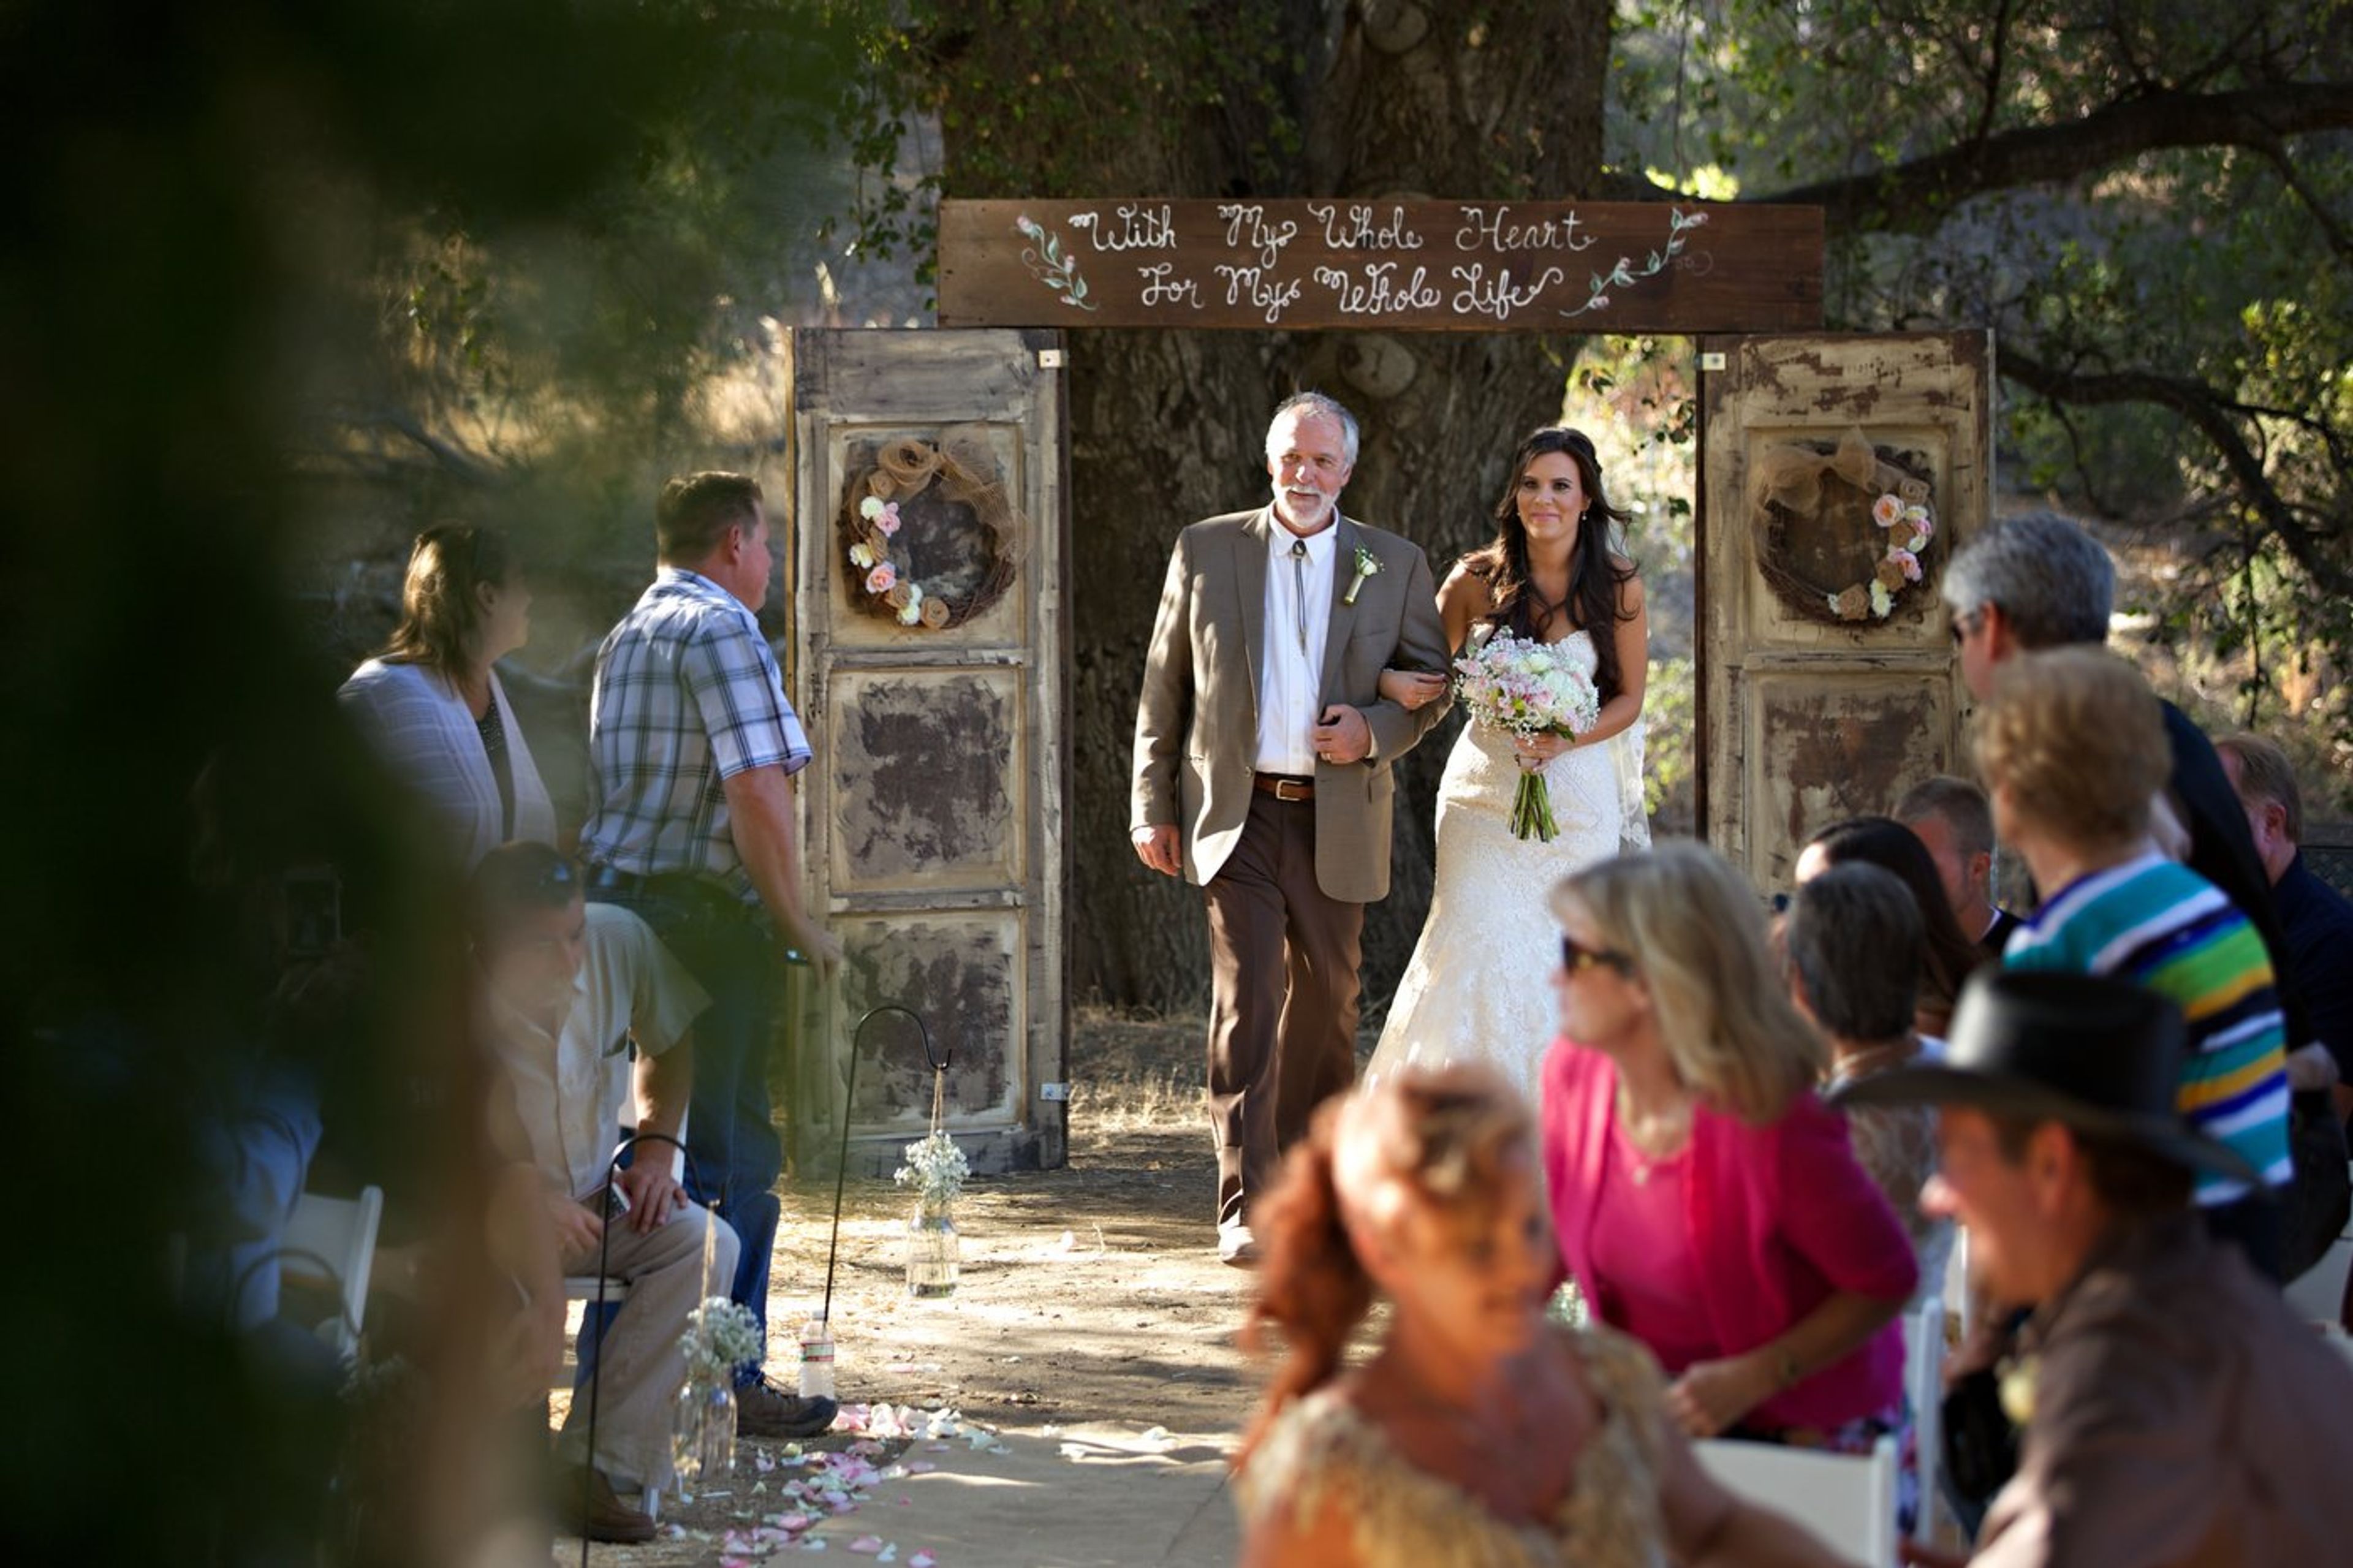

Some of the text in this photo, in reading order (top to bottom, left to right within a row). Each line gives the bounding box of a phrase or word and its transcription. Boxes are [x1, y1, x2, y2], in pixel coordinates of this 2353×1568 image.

[1068, 202, 1597, 268] With My Whole Heart
[1138, 262, 1564, 324] For My Whole Life
